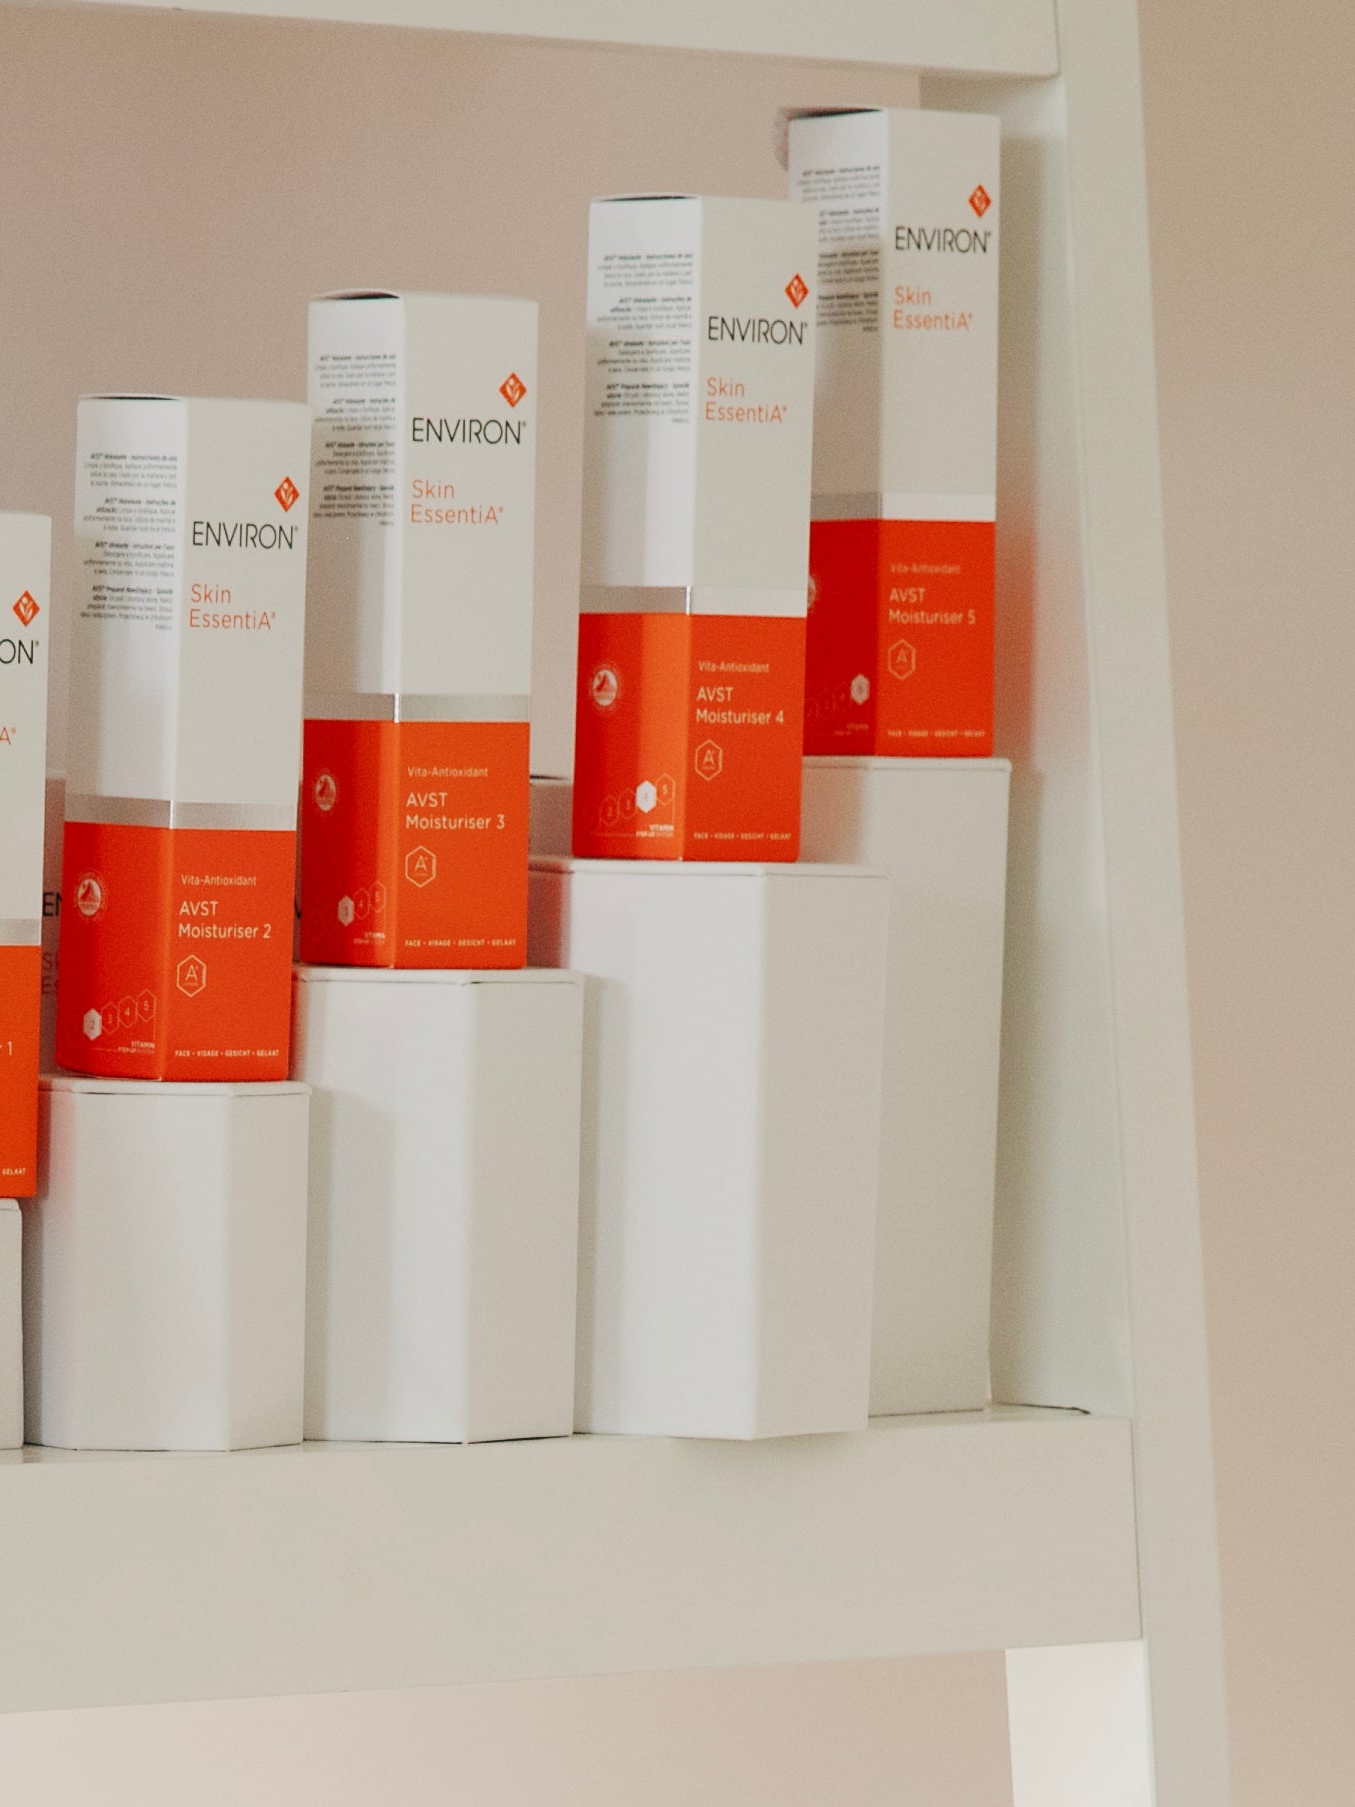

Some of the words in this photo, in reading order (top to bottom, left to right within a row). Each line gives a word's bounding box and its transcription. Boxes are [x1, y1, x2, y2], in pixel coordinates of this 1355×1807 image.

[895, 285, 931, 305] Skin
[707, 377, 745, 397] Skin
[412, 480, 454, 498] Skin
[191, 584, 231, 603] Skin
[890, 588, 925, 602] AVST
[889, 609, 963, 624] Moisturiser
[968, 610, 976, 624] 5
[699, 661, 769, 672] Vita-Antioxidant
[697, 687, 733, 702] AVST
[696, 708, 771, 724] Moisturiser
[775, 709, 784, 723] 4
[408, 767, 488, 777] Vita-Antioxidant
[406, 792, 447, 807] AVST
[406, 815, 491, 829] Moisturiser
[496, 815, 505, 829] 3
[181, 875, 256, 885] Vita-Antioxidant
[180, 901, 218, 916] AVST
[179, 923, 258, 938] Moisturiser
[263, 924, 271, 939] 2
[143, 1000, 149, 1011] 5
[7, 1041, 13, 1056] 1
